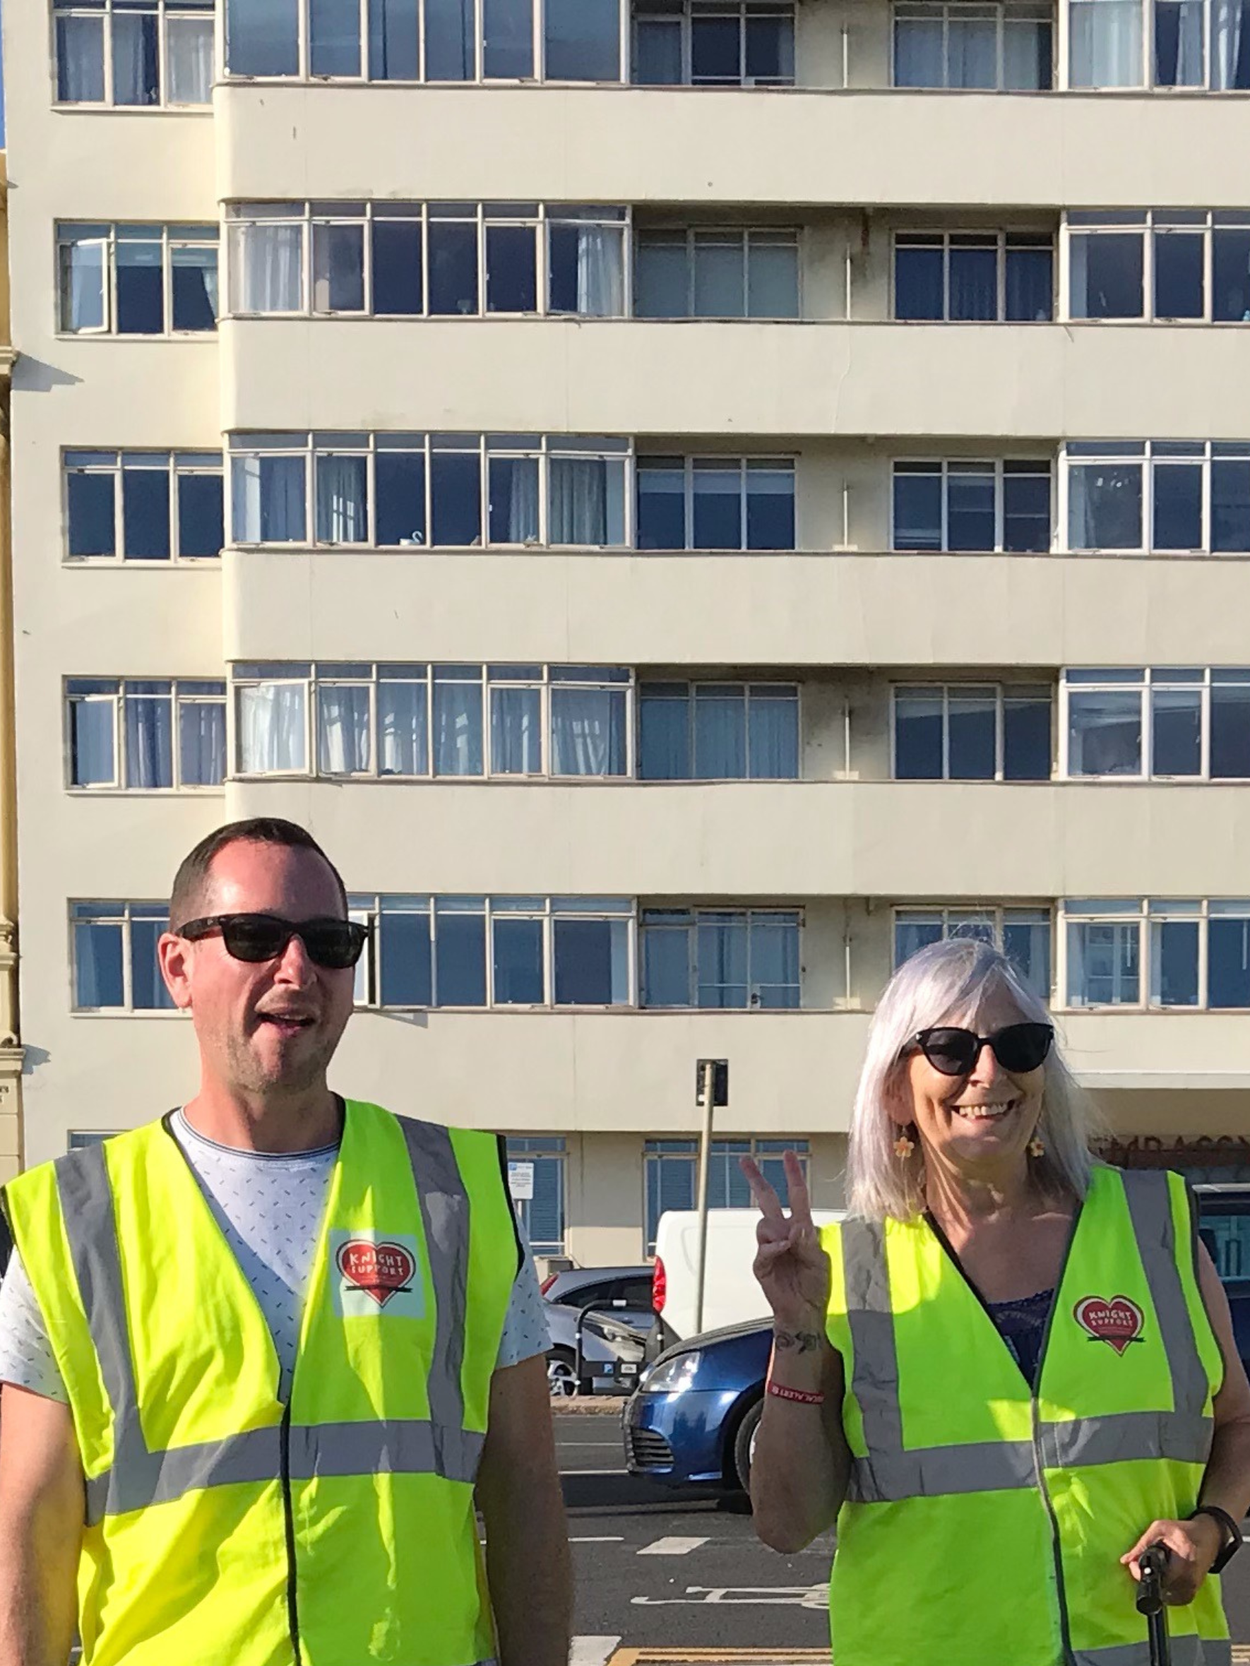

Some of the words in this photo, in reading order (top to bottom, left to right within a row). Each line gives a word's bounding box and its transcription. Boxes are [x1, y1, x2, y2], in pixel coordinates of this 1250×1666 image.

[349, 1252, 402, 1266] KNIGHT
[351, 1264, 404, 1276] SUPPORT
[1088, 1310, 1132, 1320] KNIGHT
